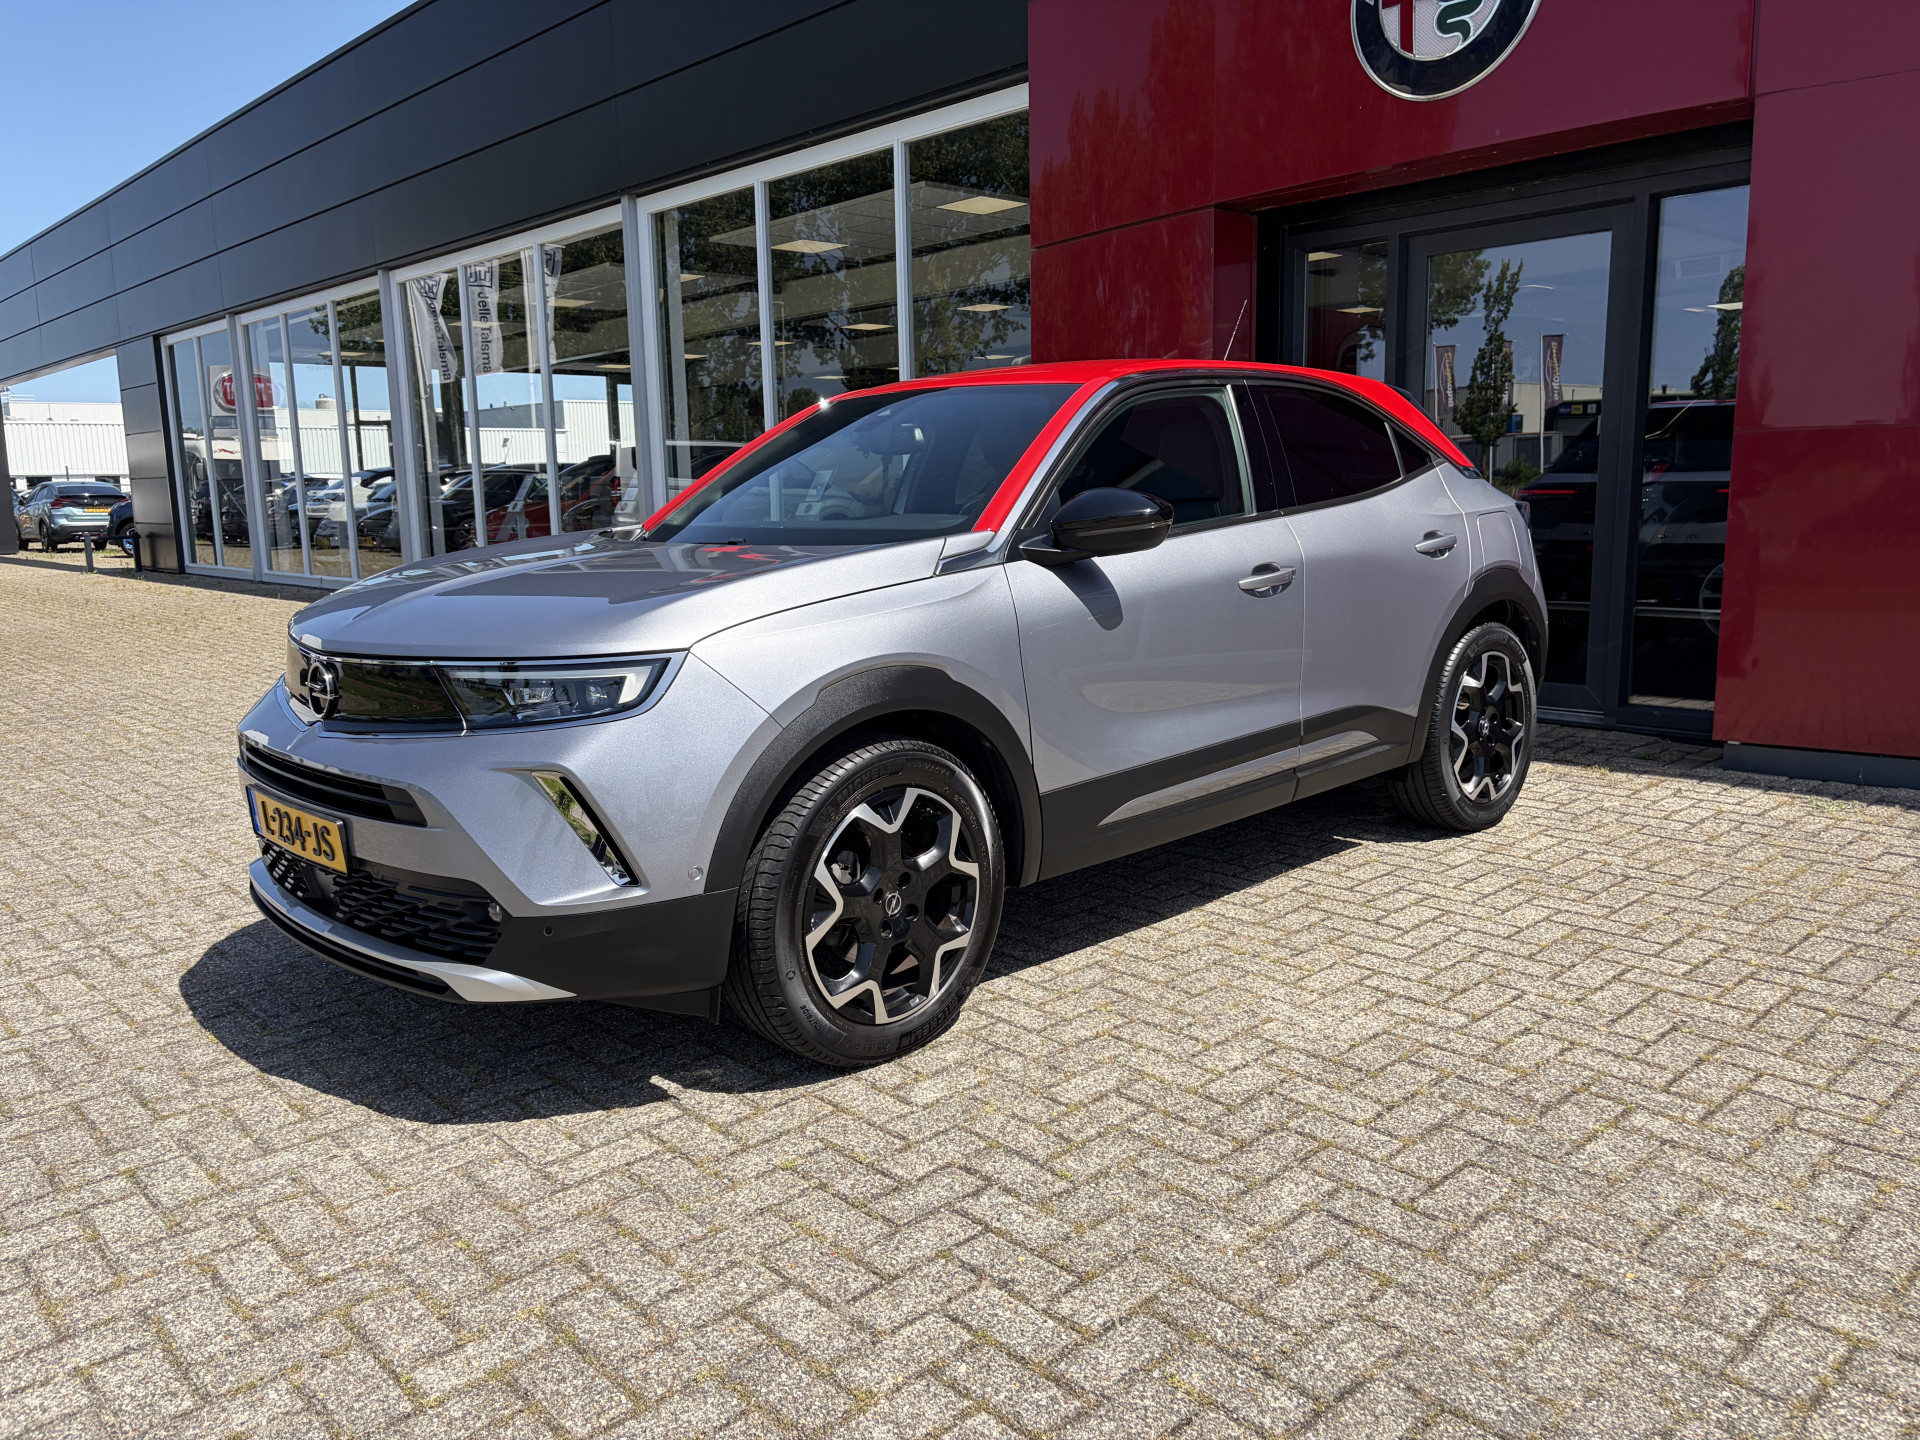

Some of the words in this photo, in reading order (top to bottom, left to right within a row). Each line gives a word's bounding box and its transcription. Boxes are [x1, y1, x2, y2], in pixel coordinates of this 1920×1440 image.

[477, 291, 491, 323] Jelle
[480, 325, 492, 373] Talsma
[261, 801, 335, 861] L-234-JS
[800, 1004, 821, 1031] OUTSIDE
